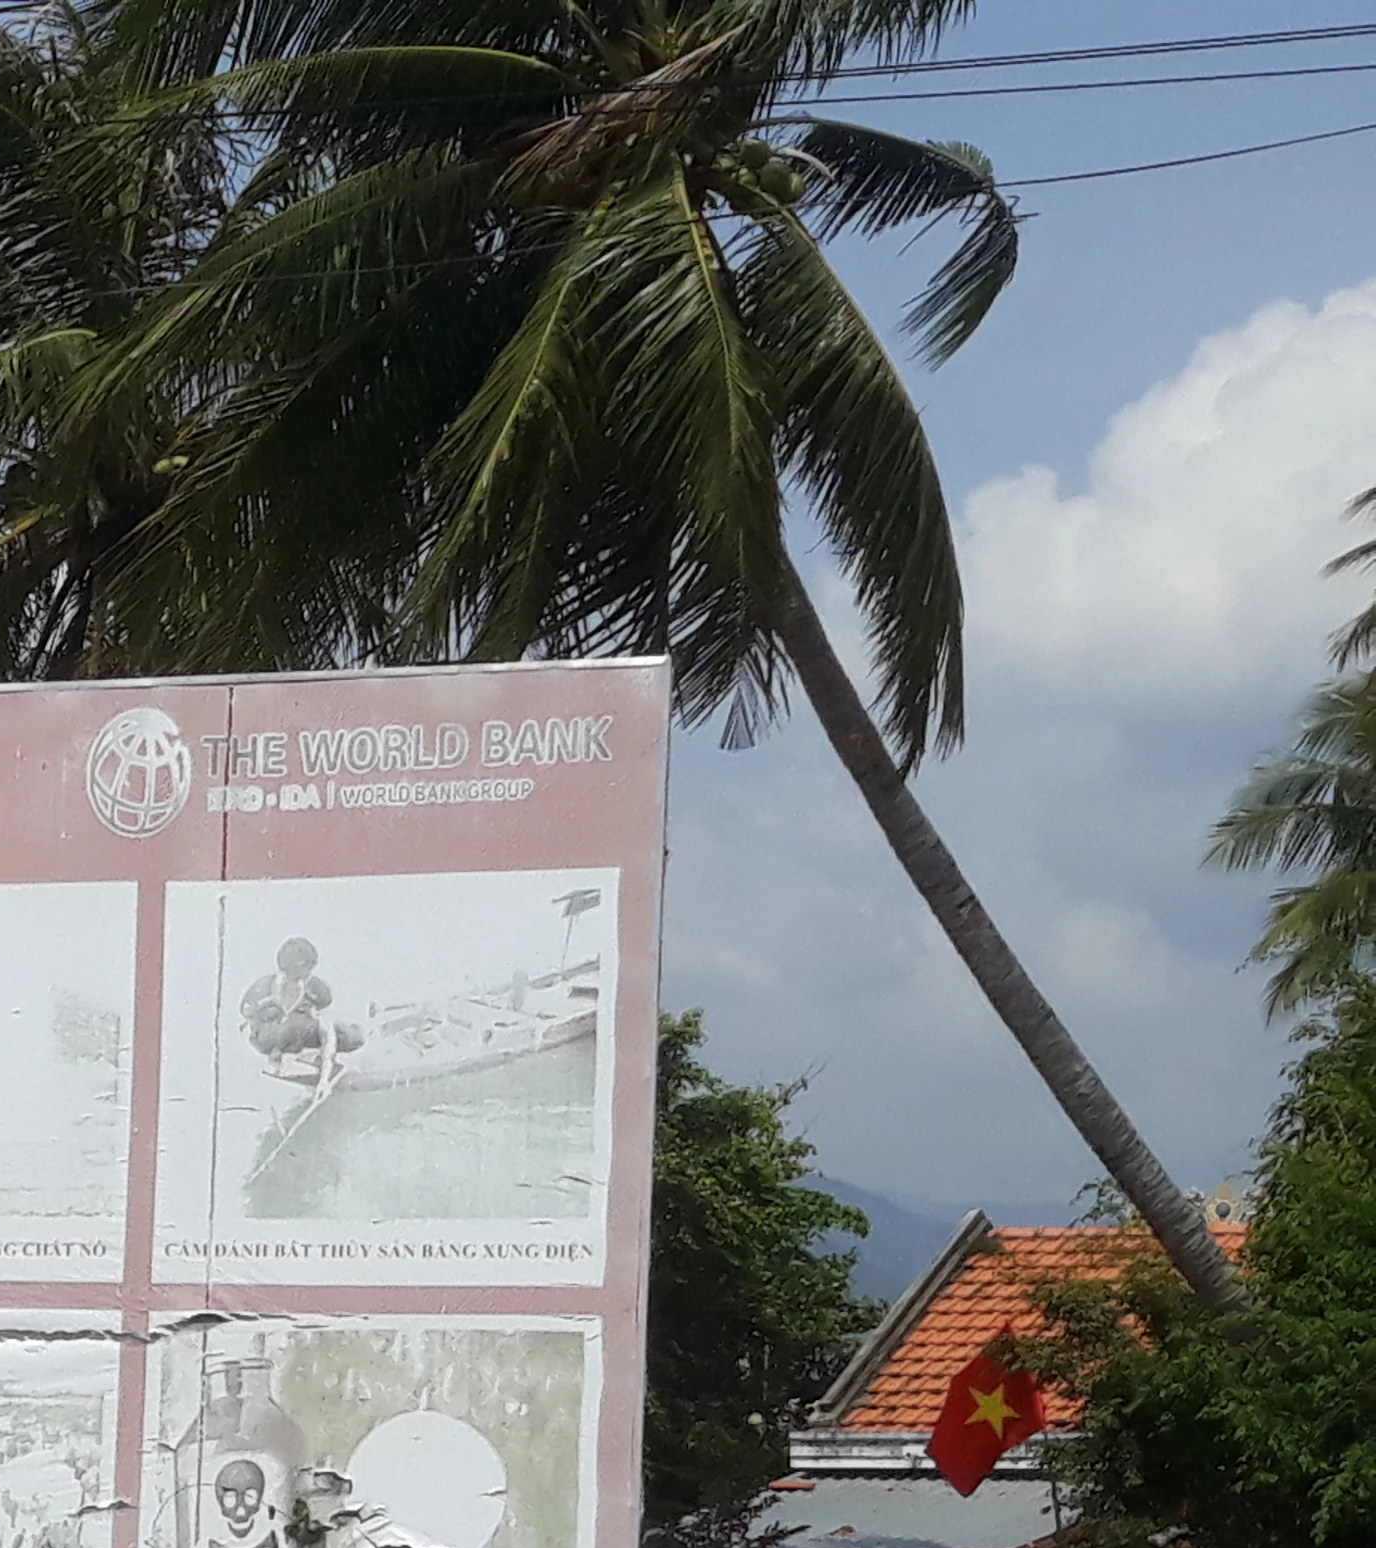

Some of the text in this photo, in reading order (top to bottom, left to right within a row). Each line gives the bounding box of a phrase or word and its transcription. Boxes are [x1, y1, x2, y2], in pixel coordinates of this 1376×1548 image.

[202, 716, 614, 777] THE WORLD BANK
[341, 782, 411, 809] WORLD
[414, 782, 464, 804] BANK
[467, 779, 533, 802] GROUP
[483, 1243, 539, 1259] XUNG
